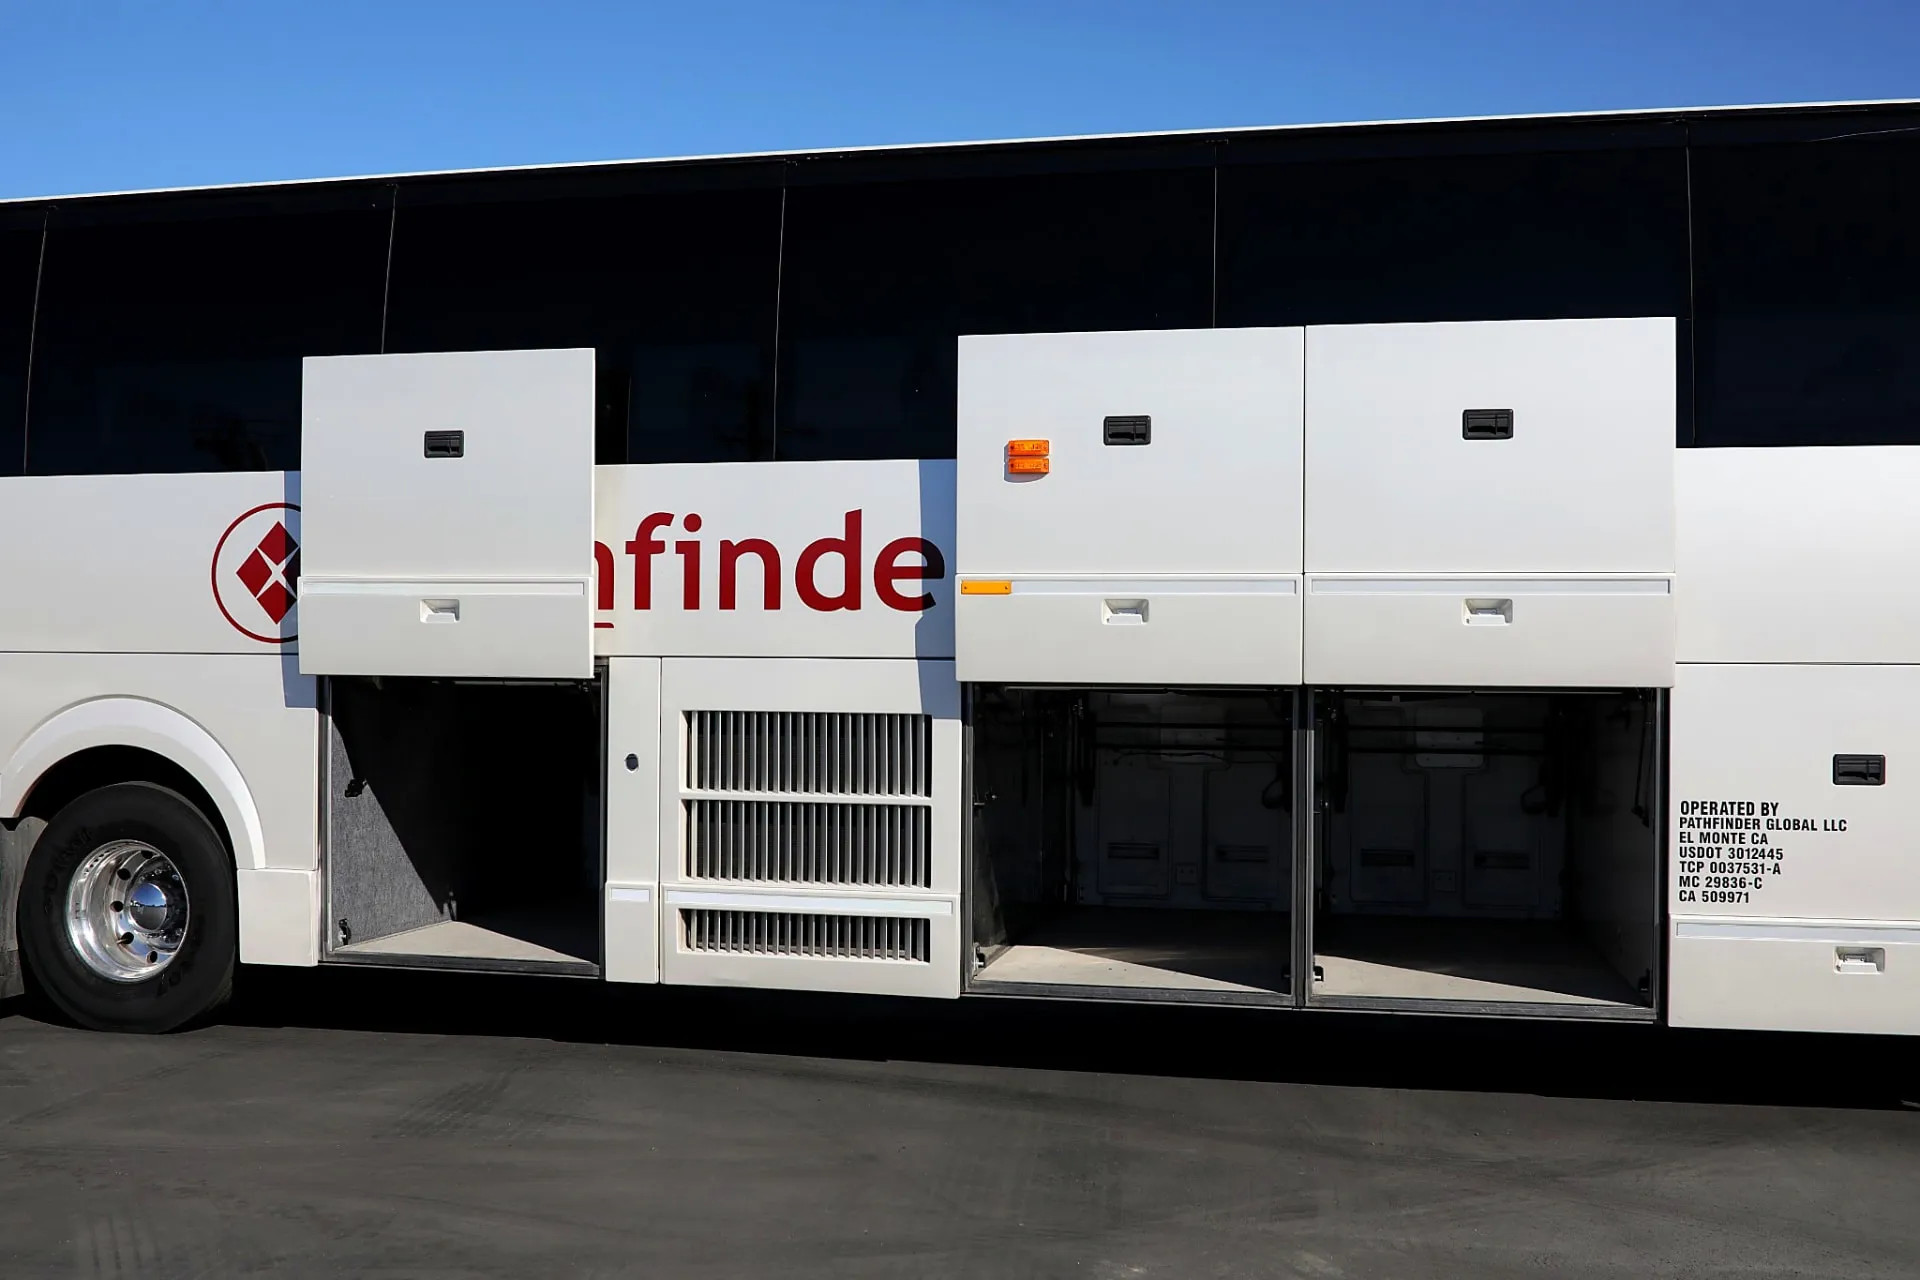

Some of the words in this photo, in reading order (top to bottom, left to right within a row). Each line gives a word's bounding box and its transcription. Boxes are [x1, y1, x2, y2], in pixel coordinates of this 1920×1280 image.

[1680, 800, 1755, 816] OPERATED
[1760, 801, 1780, 817] BY
[1679, 816, 1761, 831] PATHFINDER
[1765, 818, 1818, 832] GLOBAL
[1823, 818, 1848, 832] LLC
[1679, 831, 1695, 844] EL
[1699, 832, 1747, 845] MONTE
[1750, 832, 1769, 845] CA
[1679, 846, 1723, 859] USDOT
[1727, 847, 1784, 861] 3012445
[1679, 860, 1705, 874] TCP
[1709, 861, 1782, 876] 0037531-A
[1679, 875, 1701, 888] MC
[1704, 876, 1763, 890] 29836-C
[1678, 889, 1697, 903] CA
[1701, 890, 1749, 904] 509971
